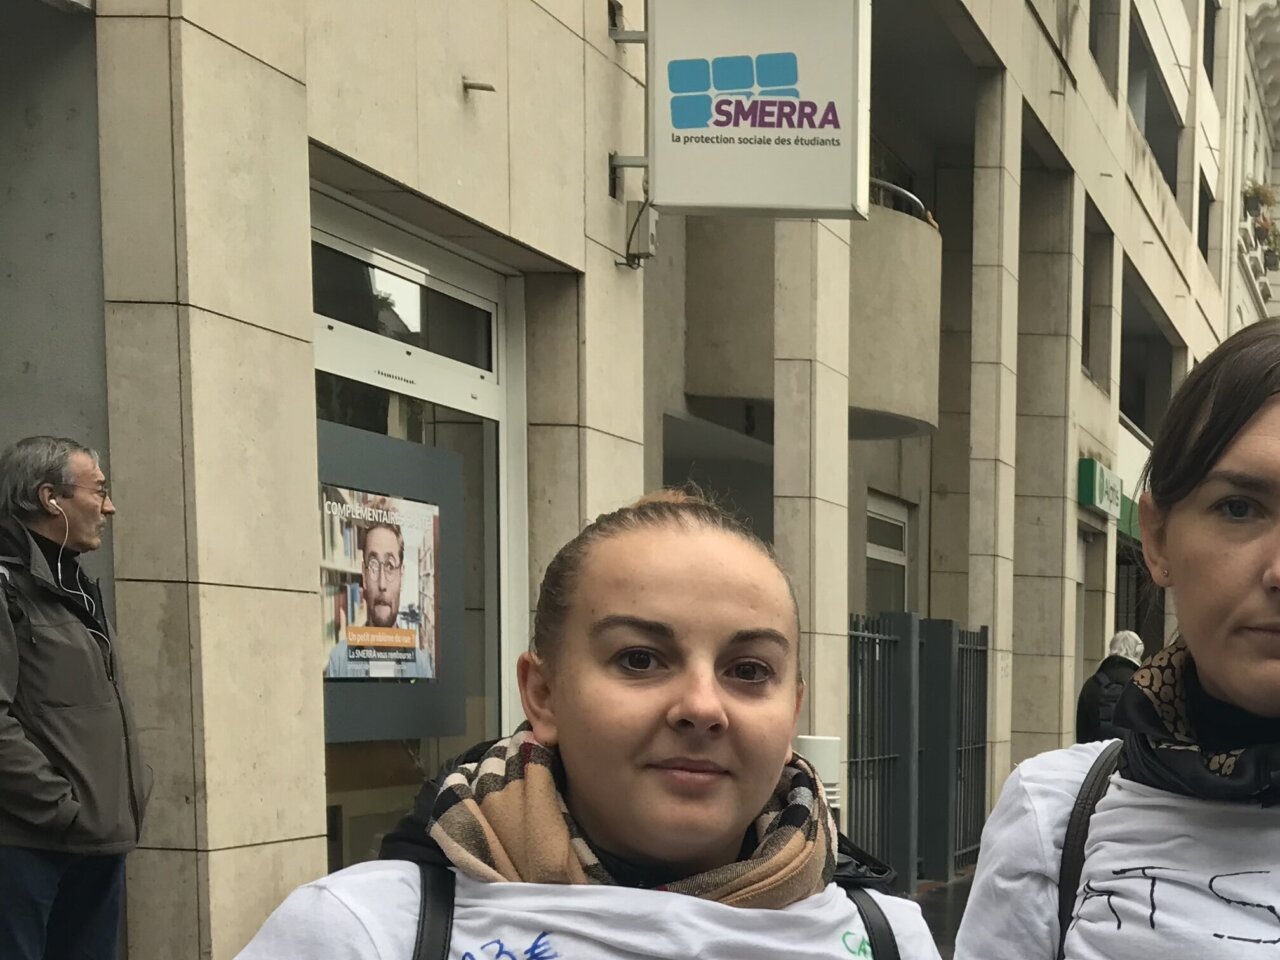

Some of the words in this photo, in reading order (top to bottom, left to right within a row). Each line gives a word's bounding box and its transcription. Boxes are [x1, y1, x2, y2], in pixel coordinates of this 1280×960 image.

[713, 98, 841, 129] SMERRA
[671, 133, 681, 143] la
[683, 134, 735, 145] protection
[738, 135, 772, 145] sociale
[774, 136, 791, 146] des
[794, 136, 841, 147] étudiants
